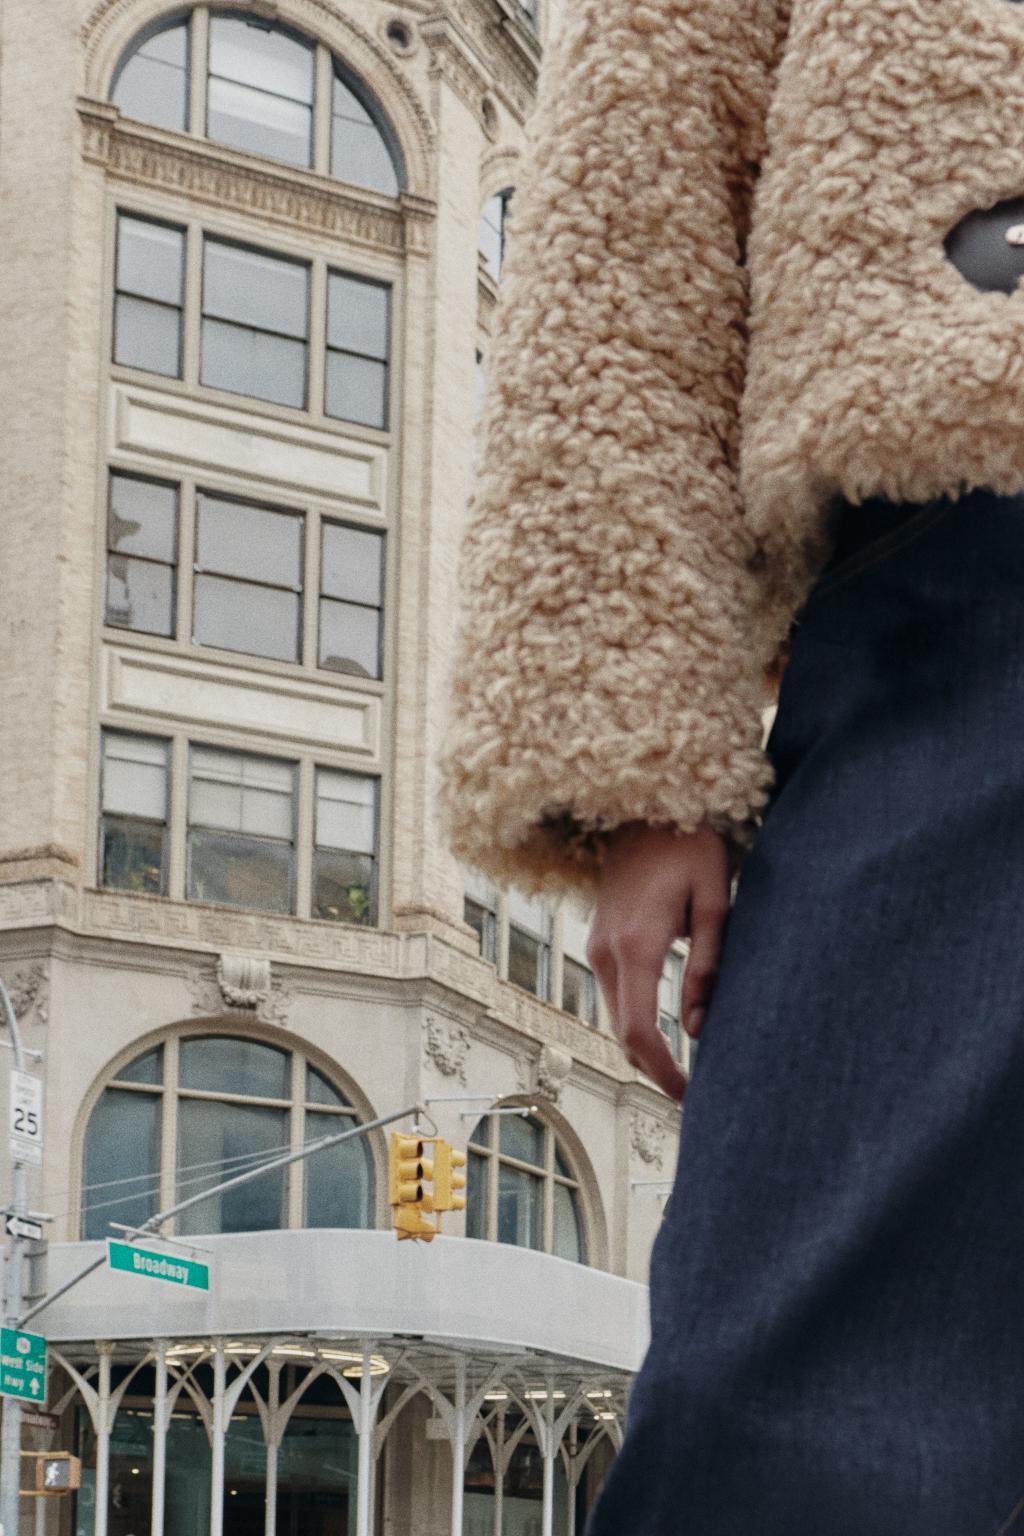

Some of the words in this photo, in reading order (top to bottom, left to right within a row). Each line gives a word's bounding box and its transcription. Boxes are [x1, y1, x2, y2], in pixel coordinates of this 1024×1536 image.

[14, 1107, 38, 1136] 25
[133, 1252, 189, 1285] Broadway
[1, 1355, 24, 1370] West
[26, 1359, 44, 1374] Side
[4, 1374, 24, 1391] Hwy
